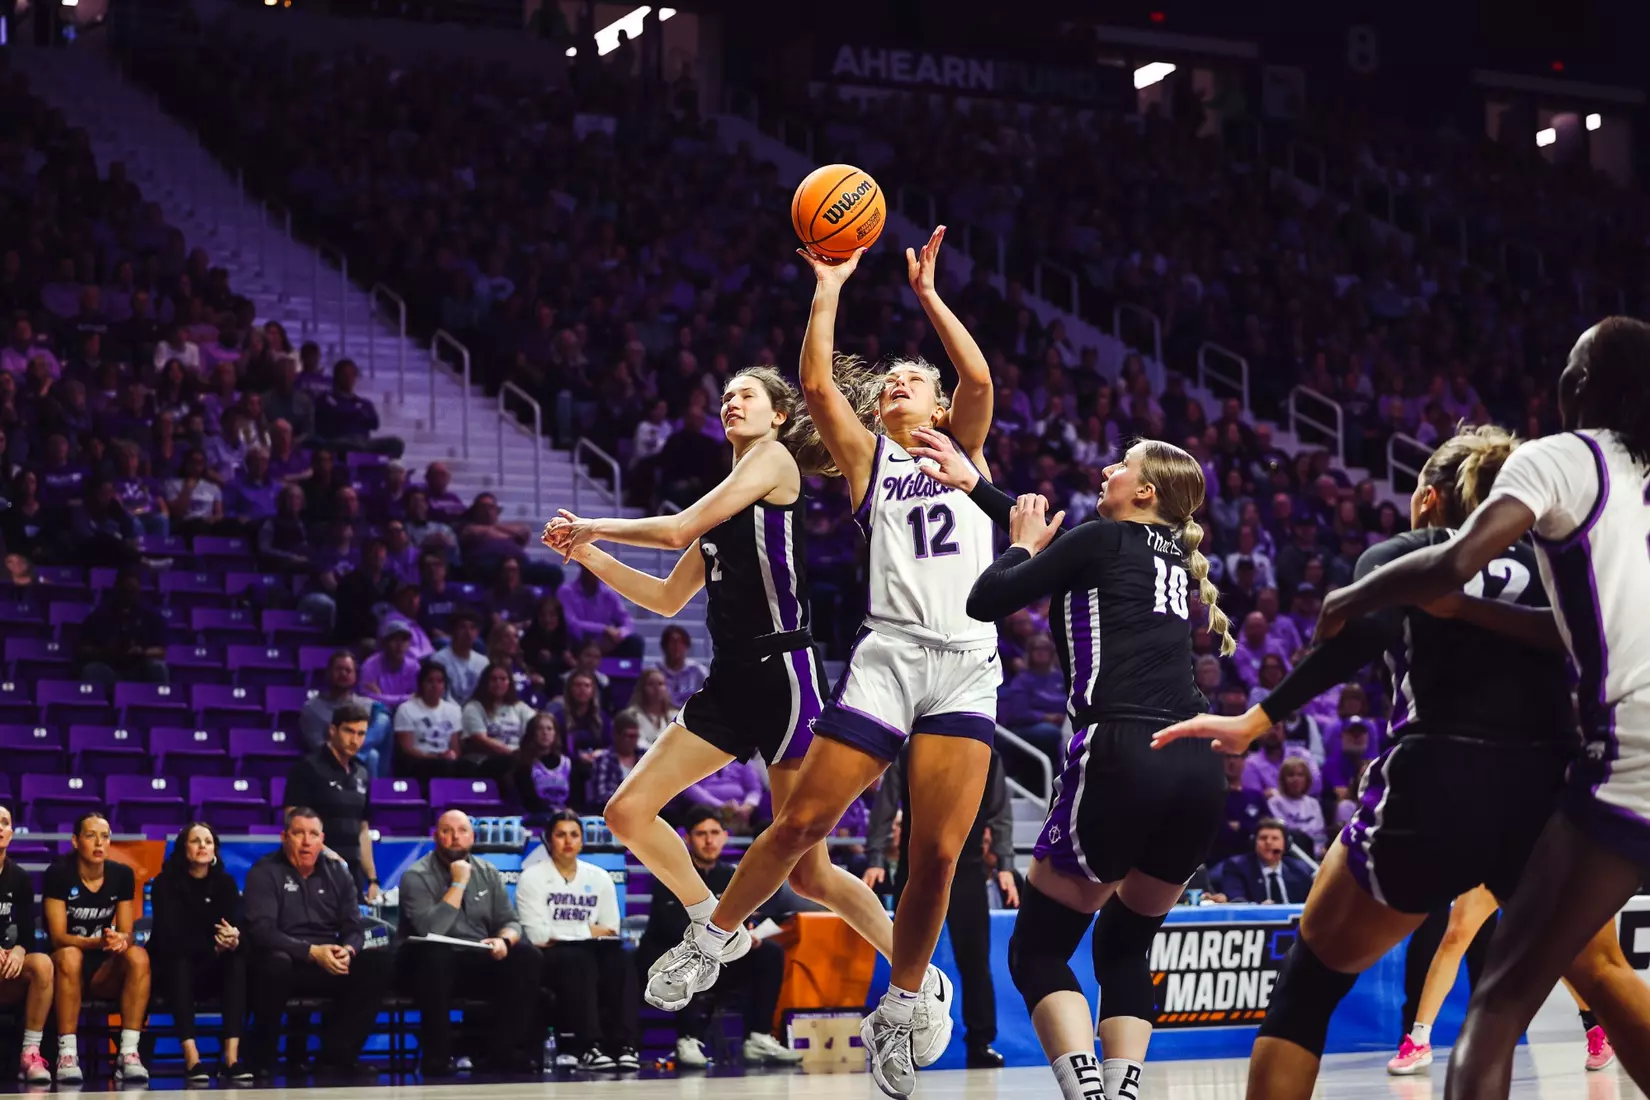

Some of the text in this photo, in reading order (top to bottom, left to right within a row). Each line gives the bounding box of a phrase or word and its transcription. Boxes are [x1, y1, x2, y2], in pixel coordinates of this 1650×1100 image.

[831, 43, 995, 91] AHEARN
[822, 180, 873, 225] Wilson
[906, 503, 961, 559] 12
[1152, 555, 1189, 620] 10
[1463, 557, 1531, 604] 2
[547, 892, 598, 908] PORTLAND
[553, 906, 592, 921] ENERGY
[1149, 929, 1266, 971] MARCH
[1163, 970, 1280, 1012] MADNE
[1069, 1054, 1111, 1100] ELIT
